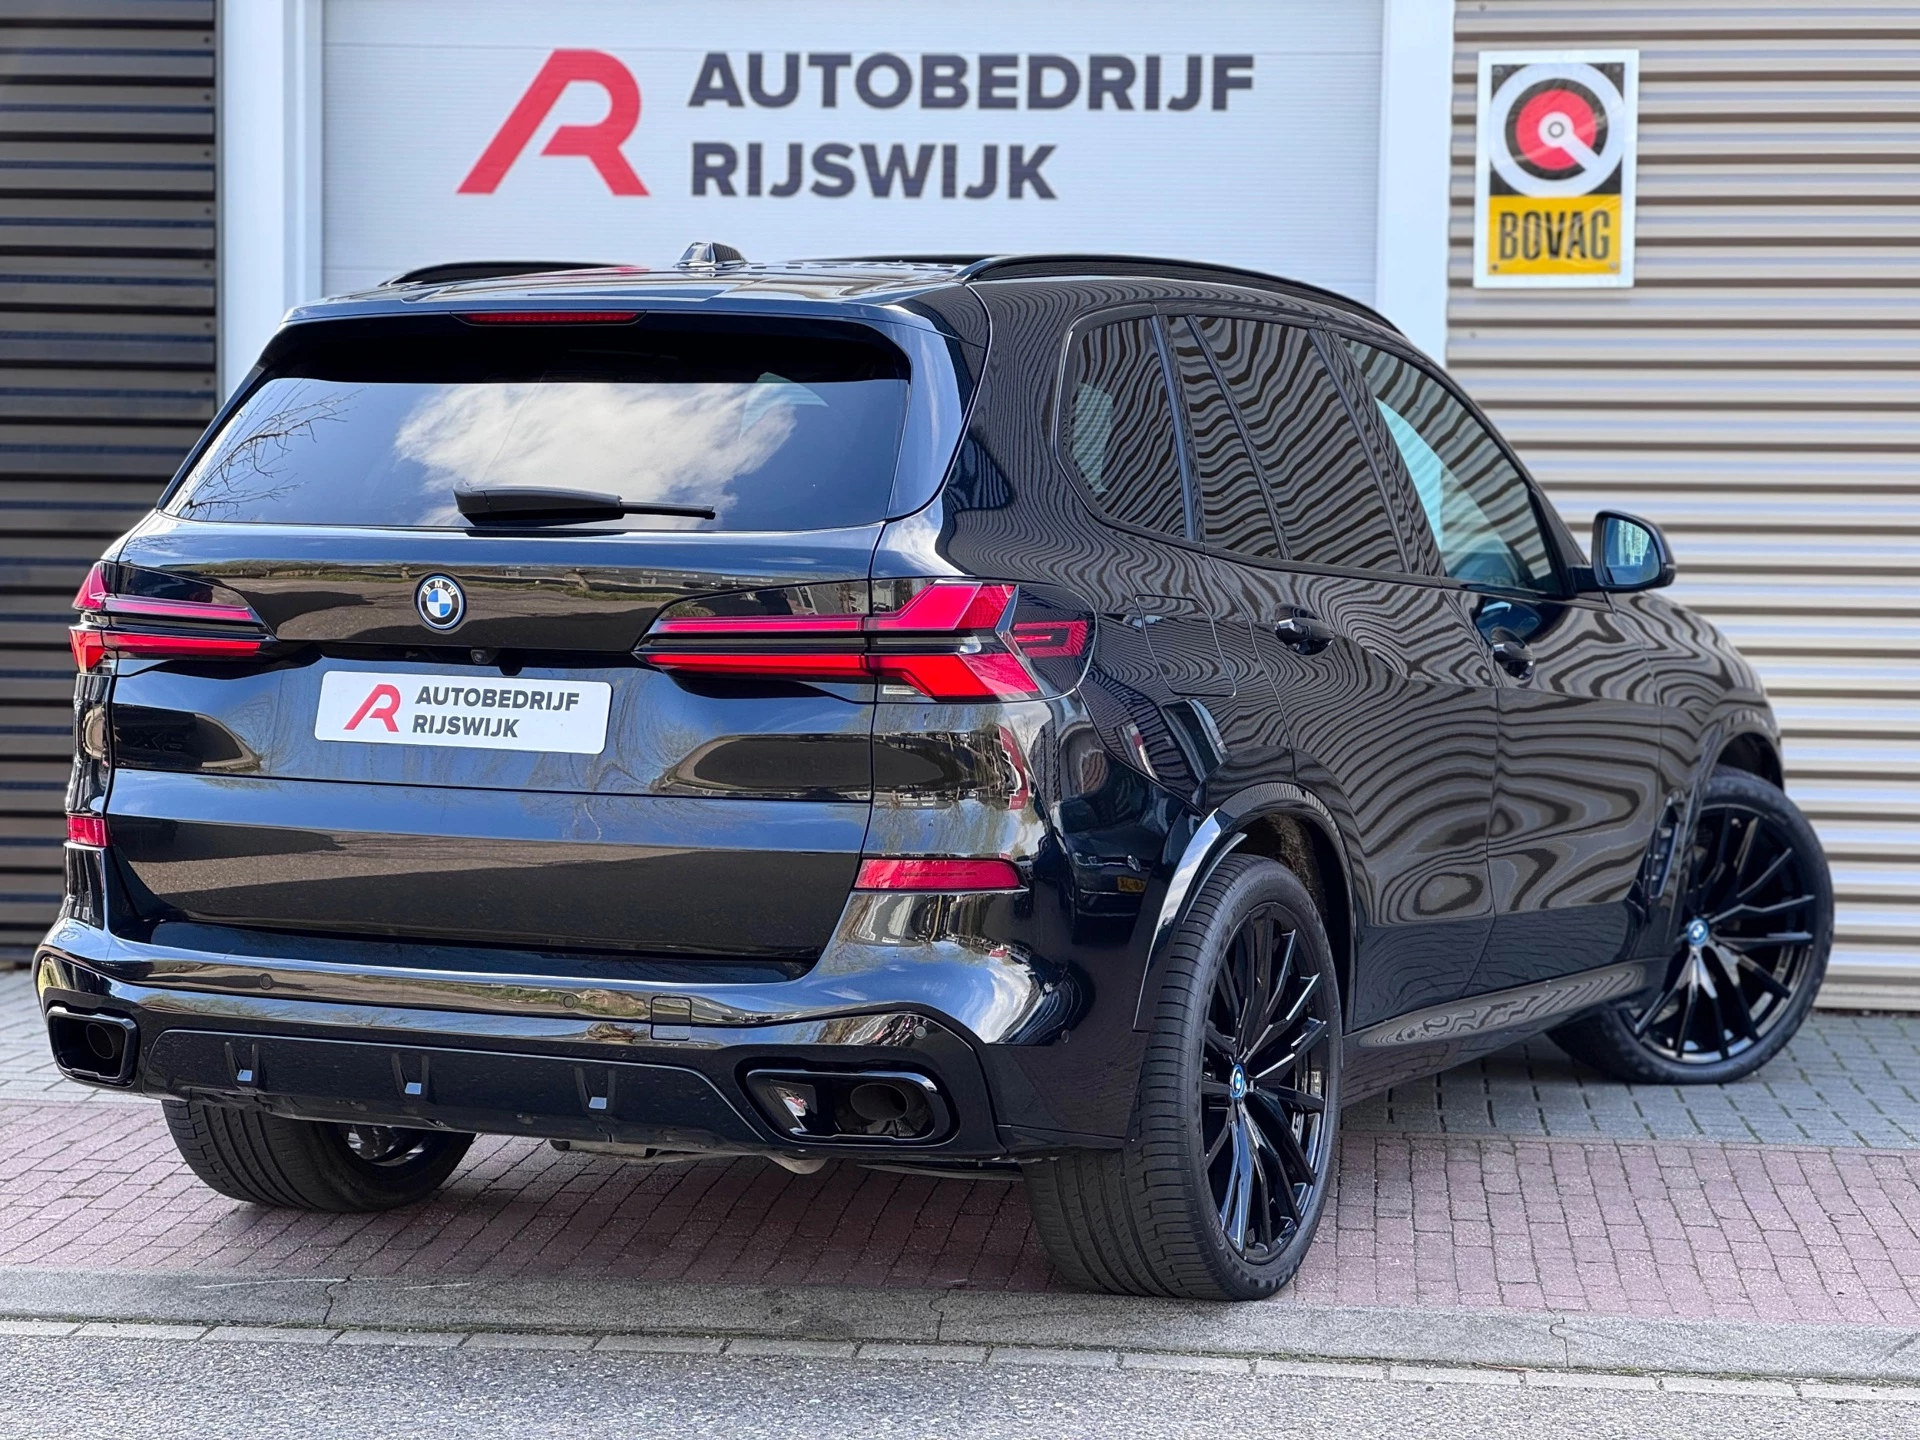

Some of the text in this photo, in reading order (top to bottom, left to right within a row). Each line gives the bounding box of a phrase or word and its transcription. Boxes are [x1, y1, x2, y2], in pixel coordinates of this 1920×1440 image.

[688, 52, 1254, 111] AUTOBEDRIJF
[691, 141, 1058, 200] RIJSWIJK
[1499, 210, 1610, 261] BOVAG
[423, 580, 457, 597] BMW
[415, 686, 579, 712] AUTOBEDRIJF
[412, 714, 519, 738] RIJSWIJK
